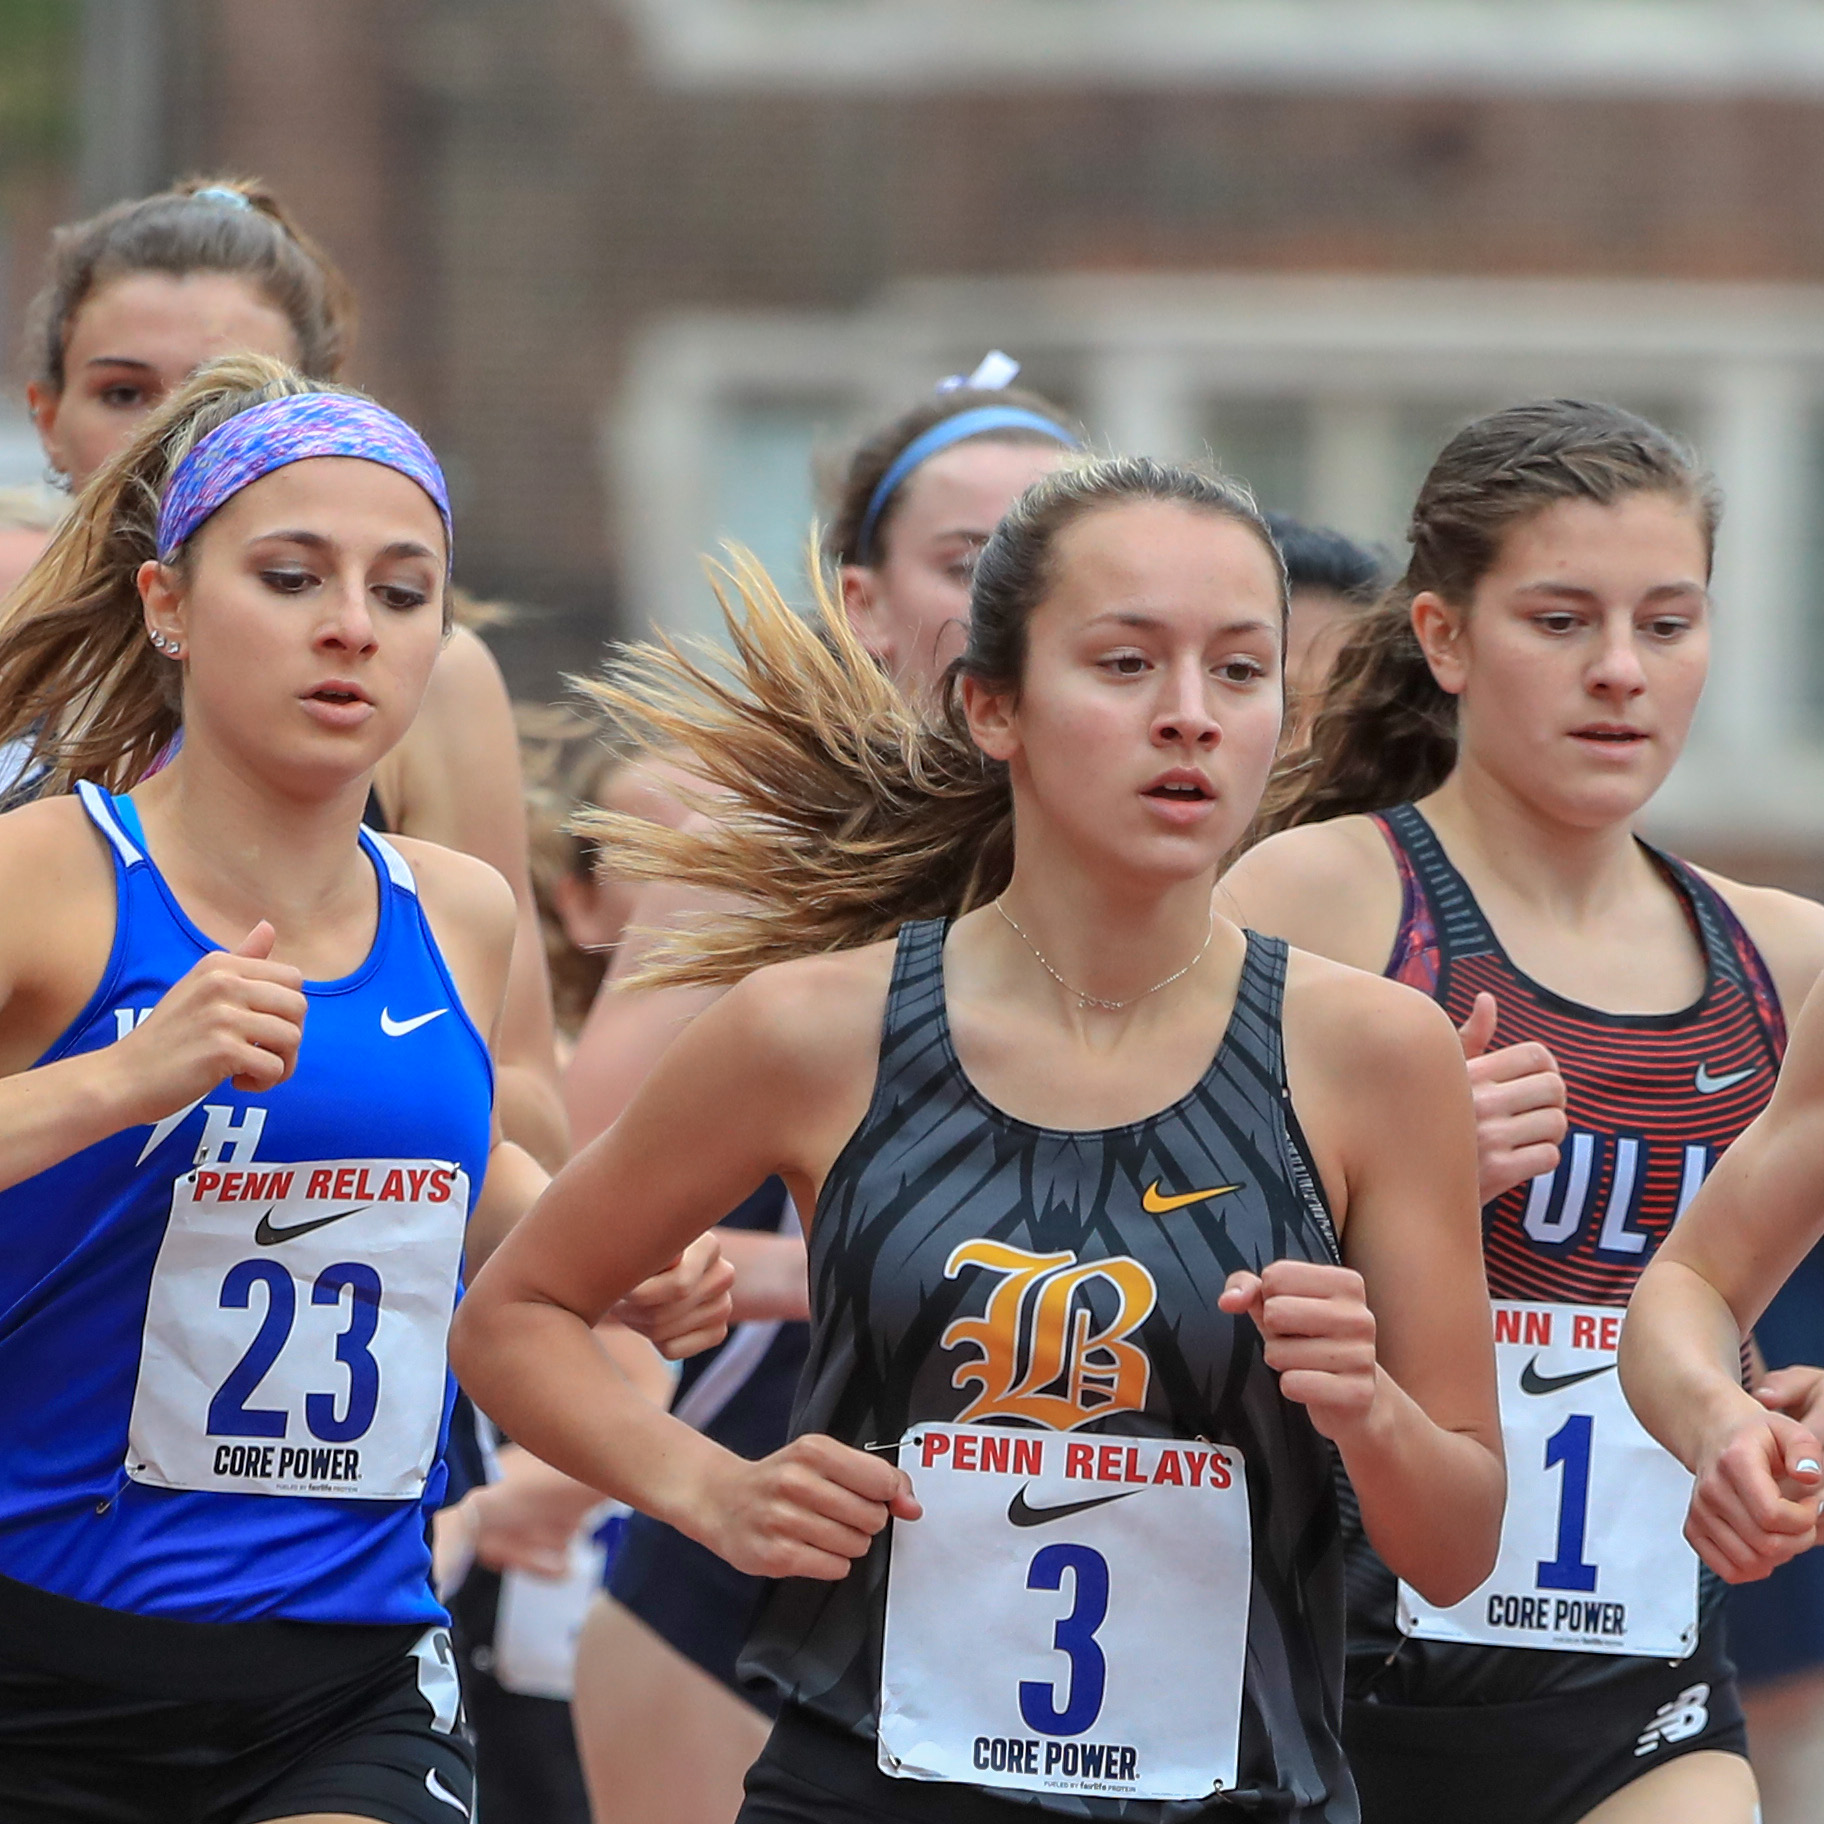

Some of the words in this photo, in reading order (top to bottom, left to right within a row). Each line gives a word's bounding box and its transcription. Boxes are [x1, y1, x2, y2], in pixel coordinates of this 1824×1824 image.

[192, 1171, 295, 1202] PENN
[305, 1168, 454, 1203] RELAYS
[205, 1258, 384, 1443] 23
[213, 1445, 275, 1479] CORE
[277, 1447, 360, 1481] POWER
[921, 1432, 1044, 1477] PENN
[1065, 1443, 1233, 1490] RELAYS
[1537, 1414, 1597, 1592] 1
[1018, 1542, 1110, 1737] 3
[1488, 1594, 1549, 1631] CORE
[1553, 1599, 1625, 1636] POWER
[973, 1736, 1041, 1776] CORE
[1043, 1740, 1137, 1781] POWER
